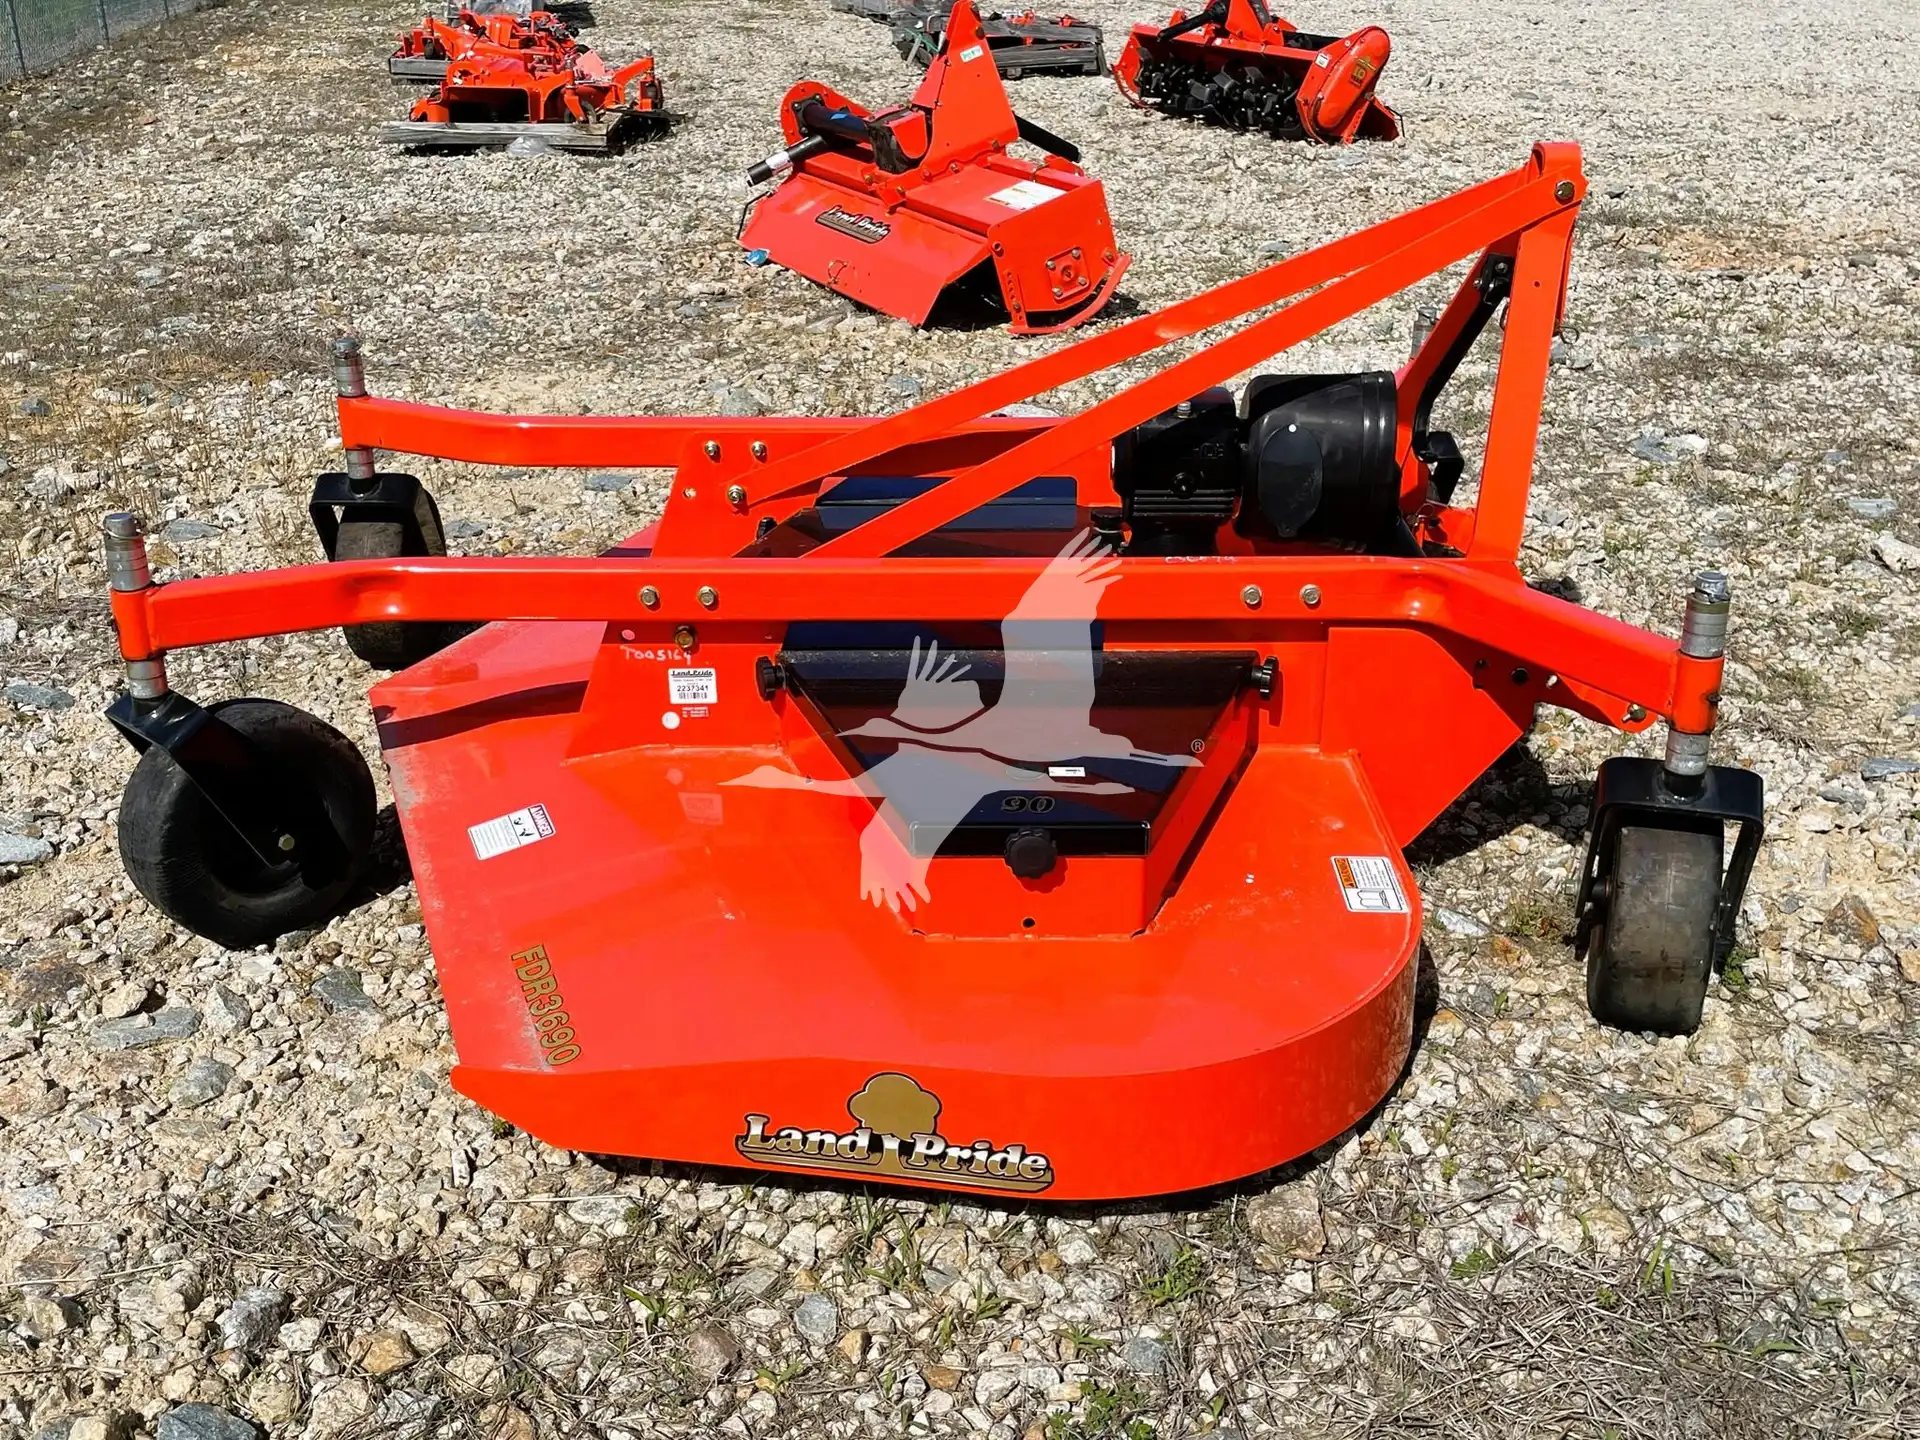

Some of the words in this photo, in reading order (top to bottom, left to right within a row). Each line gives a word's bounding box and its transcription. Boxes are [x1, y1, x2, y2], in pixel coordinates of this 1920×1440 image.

[511, 944, 581, 1067] FDR3690
[744, 1114, 873, 1160] Land
[908, 1133, 1050, 1179] Pride
